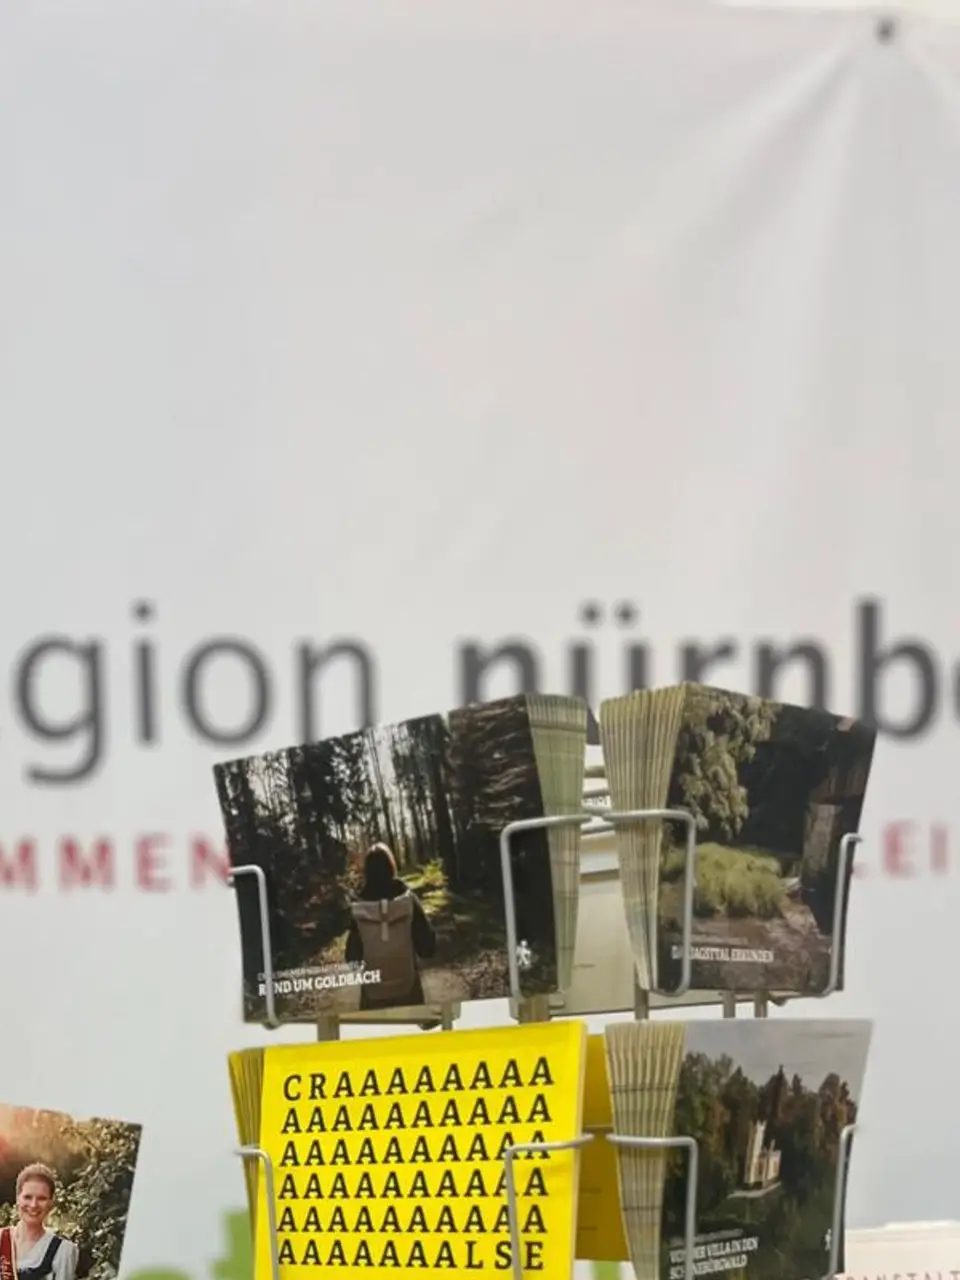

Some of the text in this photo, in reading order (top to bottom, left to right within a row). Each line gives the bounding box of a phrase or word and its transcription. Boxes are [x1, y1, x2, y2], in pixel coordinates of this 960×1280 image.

[258, 982, 292, 997] RND
[293, 978, 313, 992] UM
[314, 969, 381, 990] GOLDBACH
[283, 1056, 554, 1102] CRAAAAAAAA
[281, 1093, 552, 1134] AAAAAAAAAA
[279, 1130, 551, 1167] AAAAAAAAAA
[278, 1167, 550, 1200] AAAAAAAAAA
[277, 1204, 548, 1234] AAAAAAAAAA
[278, 1239, 545, 1271] AAAAAAALSE
